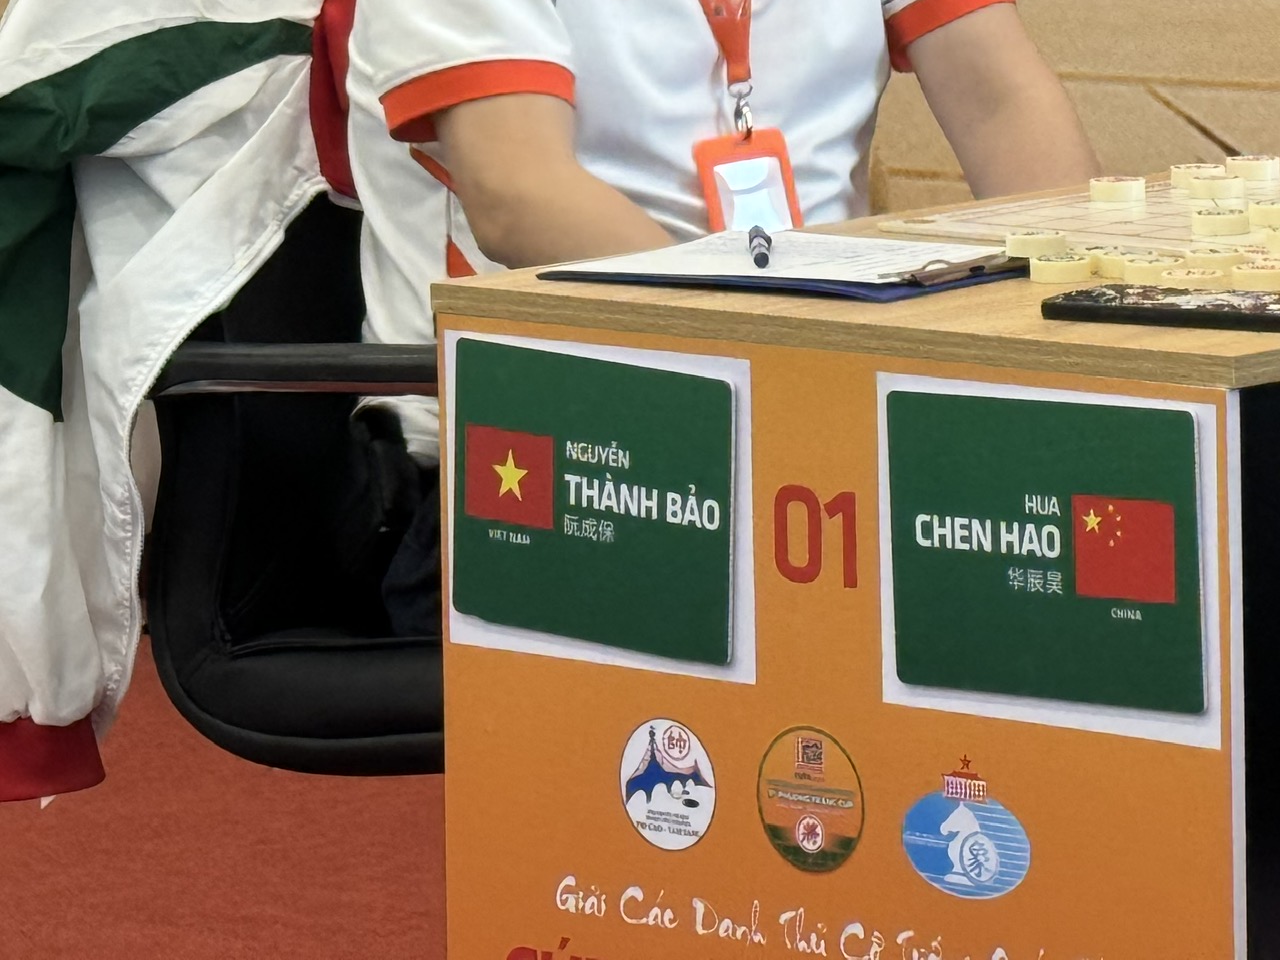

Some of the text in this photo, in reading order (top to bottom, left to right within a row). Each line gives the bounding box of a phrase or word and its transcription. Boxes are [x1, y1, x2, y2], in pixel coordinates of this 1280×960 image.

[564, 472, 720, 531] THÀNH BẢO
[1025, 494, 1061, 517] HUA
[563, 514, 615, 543] 阮成保
[774, 484, 858, 588] 01
[915, 514, 1061, 558] CHEN HAO
[1008, 567, 1064, 595] 华辰昊
[1111, 608, 1143, 621] CHINA
[556, 875, 606, 917] Giải
[619, 886, 679, 929] Các
[692, 897, 767, 946] Danh
[779, 907, 827, 957] Thủ
